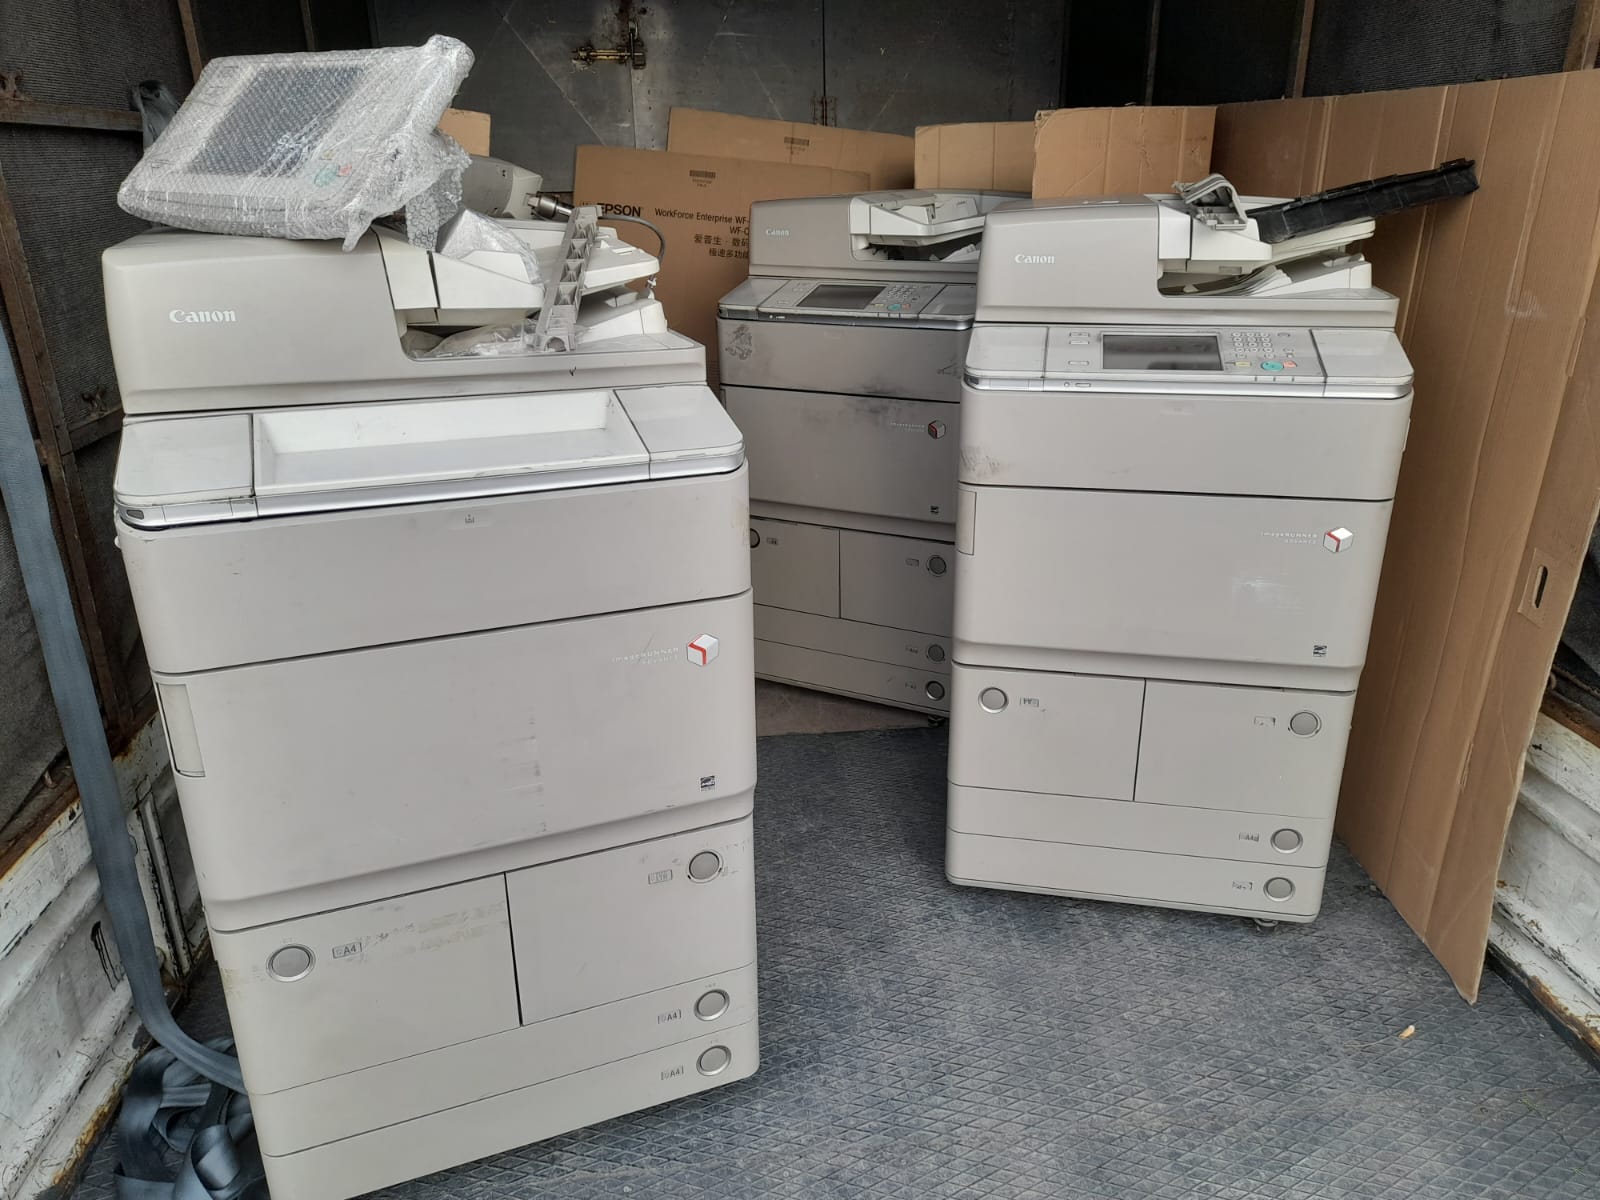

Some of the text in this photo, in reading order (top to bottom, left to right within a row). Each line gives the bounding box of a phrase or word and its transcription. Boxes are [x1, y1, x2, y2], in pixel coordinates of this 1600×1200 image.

[654, 208, 694, 220] WorkForce
[696, 211, 733, 224] Enterprise
[1014, 254, 1055, 264] Canon
[169, 309, 237, 323] Canon
[343, 945, 357, 956] A4
[667, 1011, 678, 1022] A4
[670, 1067, 681, 1078] A4
